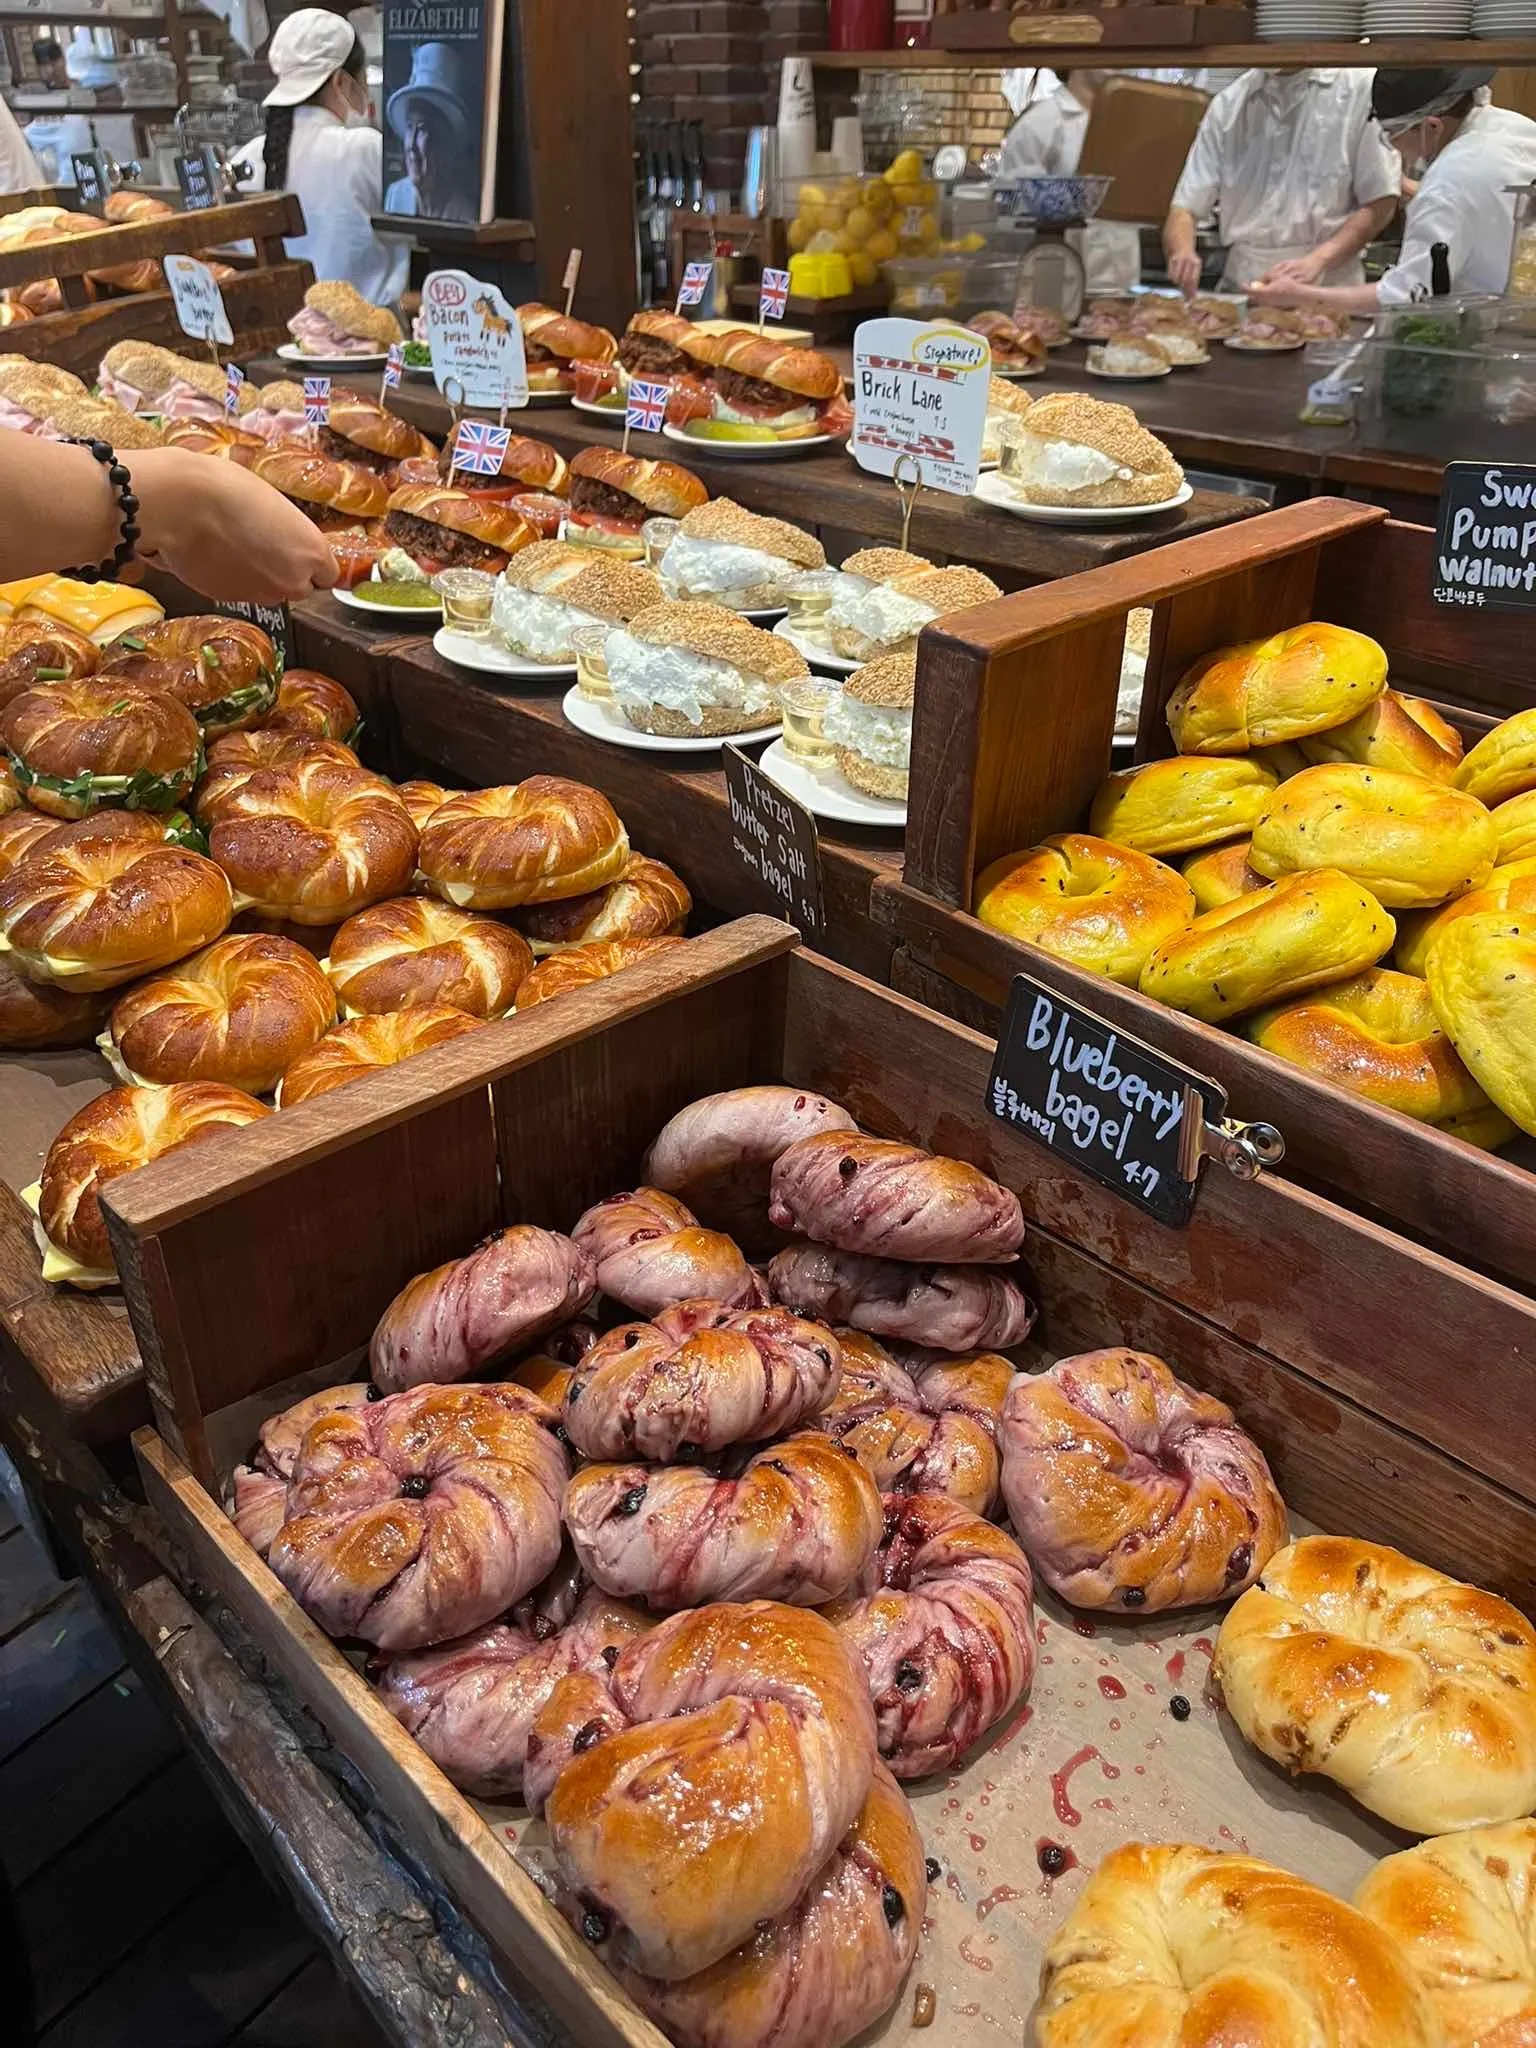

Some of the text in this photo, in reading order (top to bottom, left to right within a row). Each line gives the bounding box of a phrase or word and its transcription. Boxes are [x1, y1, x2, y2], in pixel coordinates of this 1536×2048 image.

[388, 7, 479, 30] ELIZABETH II
[430, 303, 469, 327] Bacon
[924, 343, 981, 365] Signature!
[862, 371, 902, 403] Brick
[912, 380, 943, 410] Lane
[743, 763, 796, 835] Pretzel
[729, 782, 770, 847] butter
[777, 833, 807, 881] Salt
[761, 848, 793, 903] bagel
[1026, 994, 1185, 1140] Blueberry
[992, 1076, 1057, 1145] 블루베리
[1045, 1068, 1134, 1160] bagel
